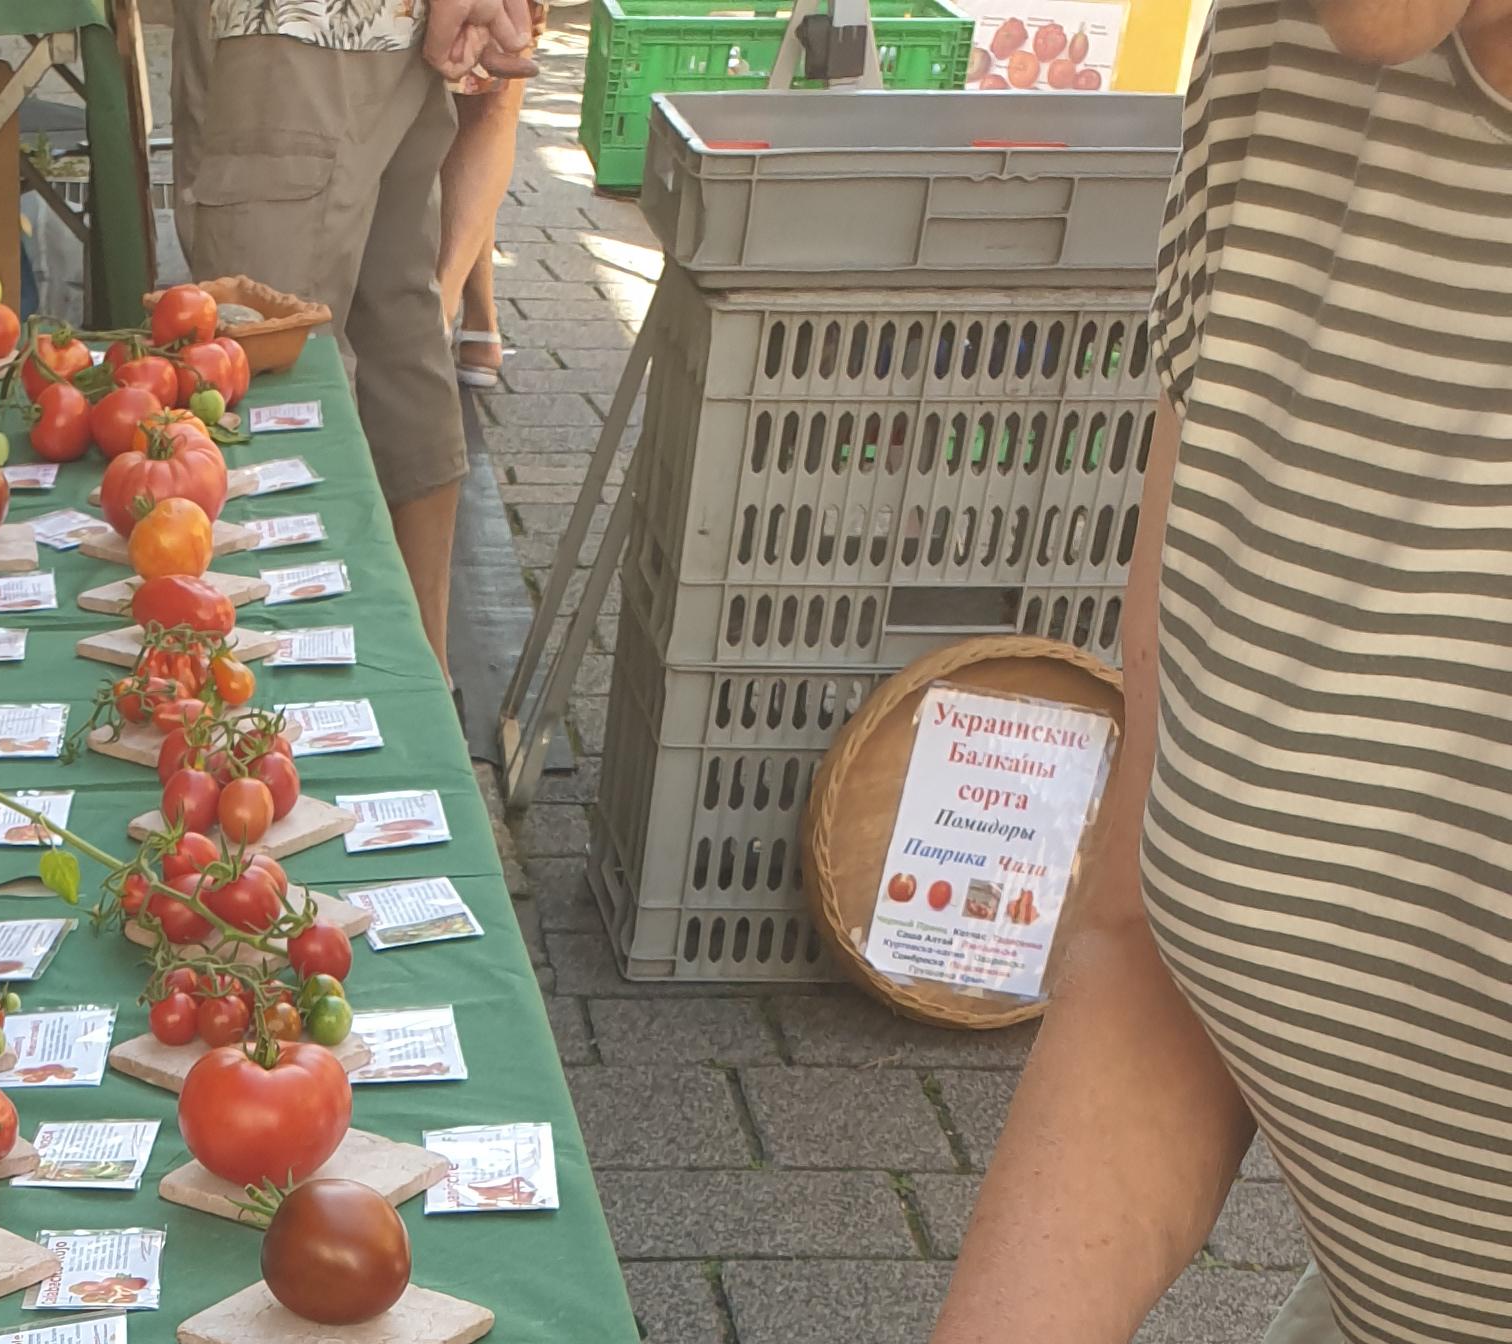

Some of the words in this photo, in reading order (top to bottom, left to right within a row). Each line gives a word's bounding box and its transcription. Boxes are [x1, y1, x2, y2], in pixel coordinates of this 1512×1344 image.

[956, 781, 1030, 812] сорта
[934, 807, 1035, 843] Помидоры
[902, 836, 986, 867] Паприка
